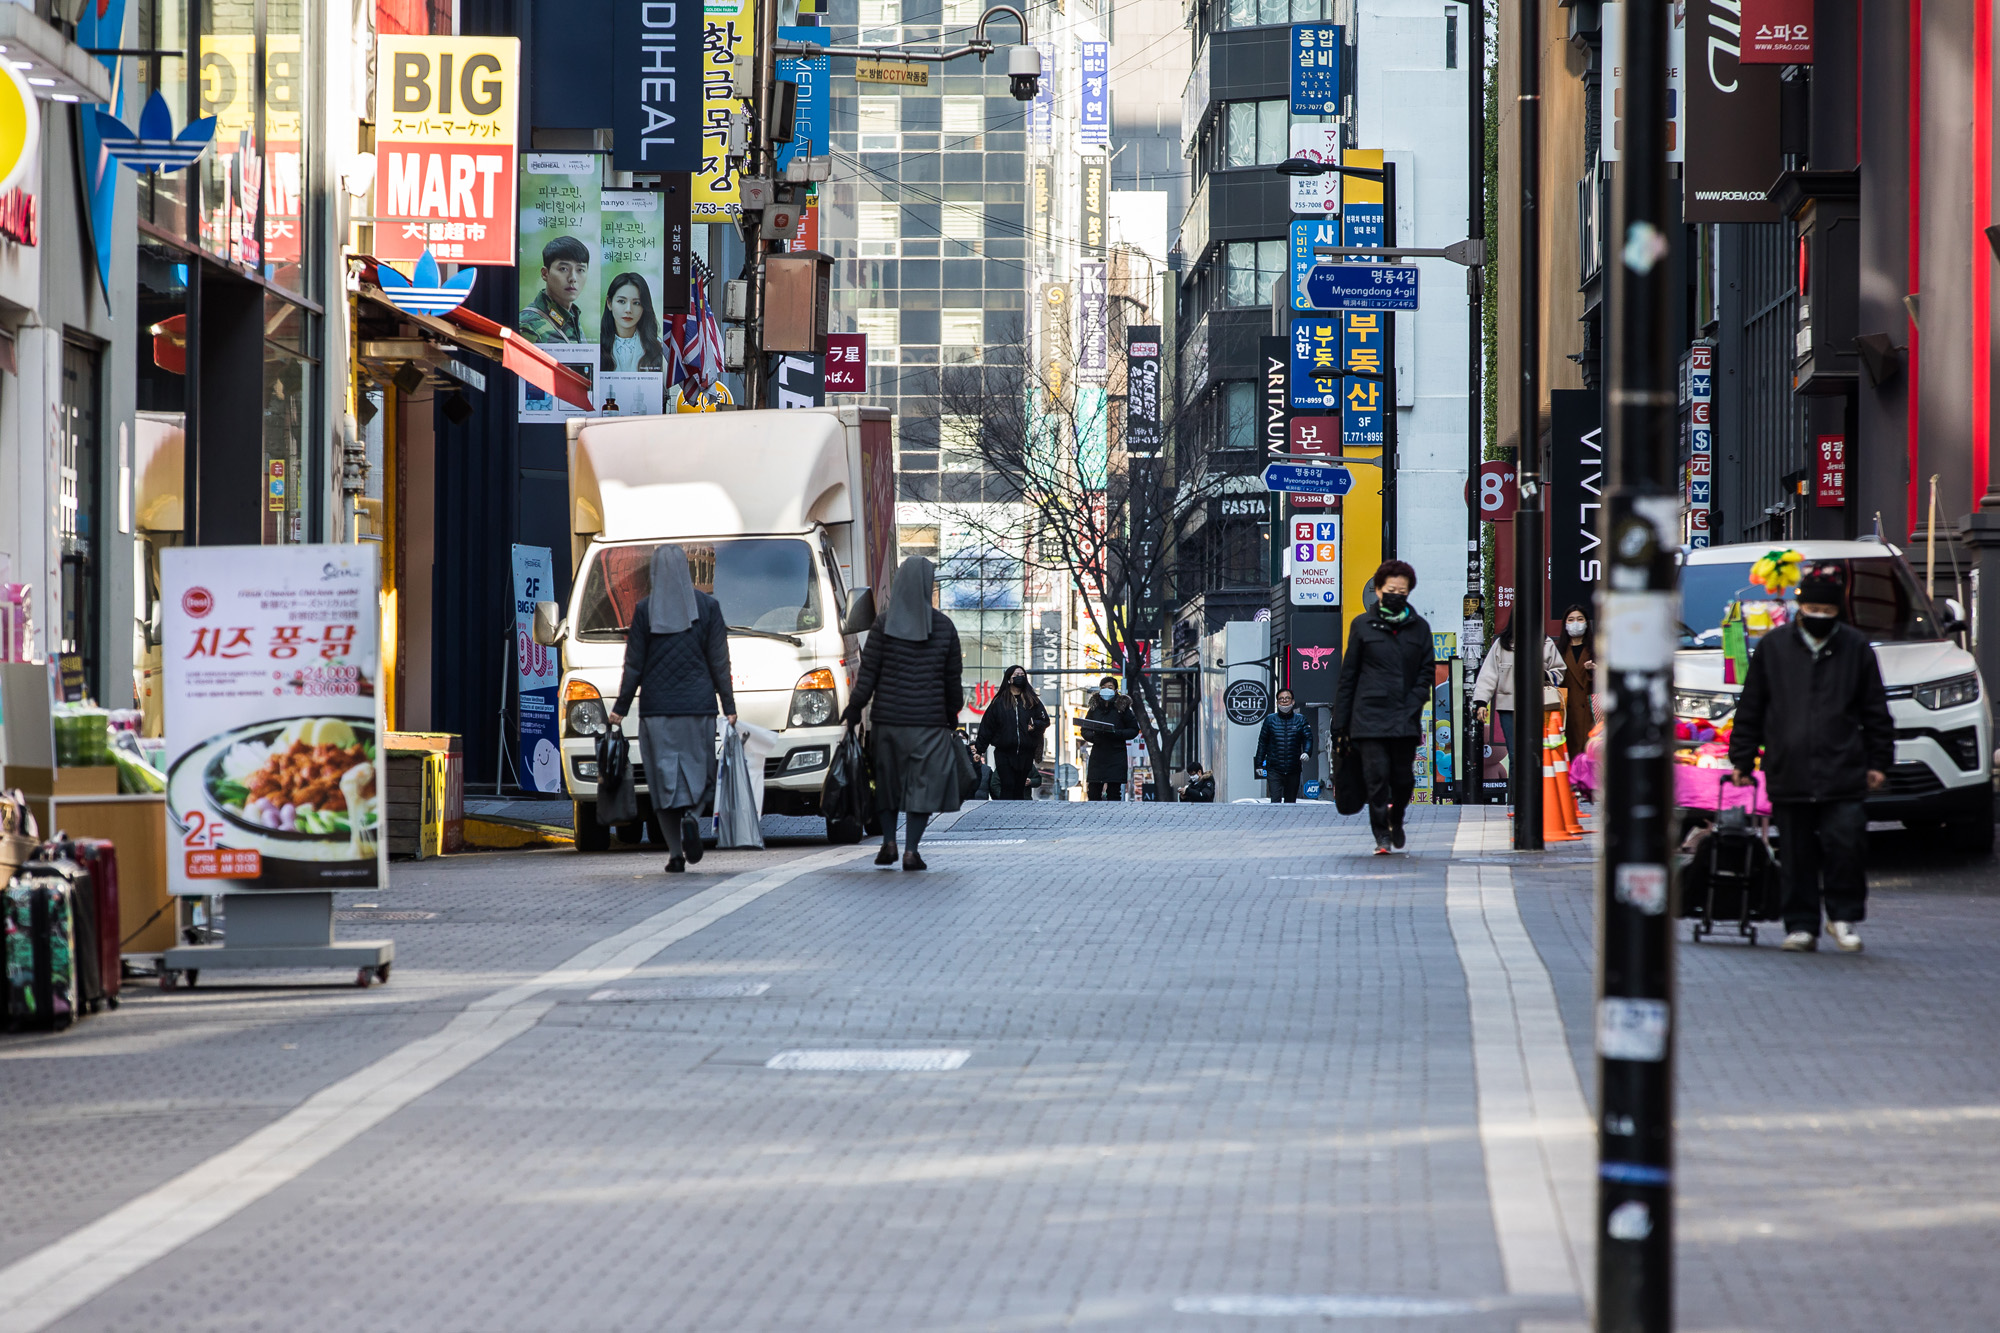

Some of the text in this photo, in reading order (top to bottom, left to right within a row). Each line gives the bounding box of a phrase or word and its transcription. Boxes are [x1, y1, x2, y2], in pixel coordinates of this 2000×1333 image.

[1299, 29, 1334, 47] 종합
[1755, 24, 1809, 41] 스파오
[1299, 50, 1333, 67] 설비
[393, 52, 502, 115] BIG
[641, 2, 676, 160] DIHEAL
[392, 118, 501, 138] スーパーマーケット
[387, 152, 503, 218] MART
[538, 186, 582, 199] 피부고민,
[535, 201, 586, 214] 메디힐에서
[538, 216, 583, 228] 해결되오!
[604, 222, 646, 234] 피부고민,
[672, 224, 681, 252] 사보이
[604, 251, 647, 263] 해결되오!
[1371, 269, 1415, 285] 명동4길
[1332, 286, 1415, 298] Myeongdong 4-gil
[1296, 325, 1311, 359] 신한
[1347, 313, 1380, 411] 부동산
[1267, 356, 1285, 458] ARITAUM
[1358, 416, 1371, 427] 3F
[1821, 441, 1844, 460] 영광
[1295, 468, 1322, 478] 명동8길
[1822, 473, 1843, 487] 커플
[1222, 500, 1265, 514] PASTA
[525, 577, 540, 599] 2F
[1295, 577, 1335, 585] EXCHANGE
[517, 600, 530, 613] BIG
[184, 625, 357, 661] 치즈 퐁~닭
[518, 631, 547, 677] 90
[1302, 661, 1329, 670] BOY
[1234, 684, 1260, 694] believe
[1232, 697, 1264, 709] belif
[1306, 785, 1320, 793] ADT
[185, 811, 223, 847] 2F
